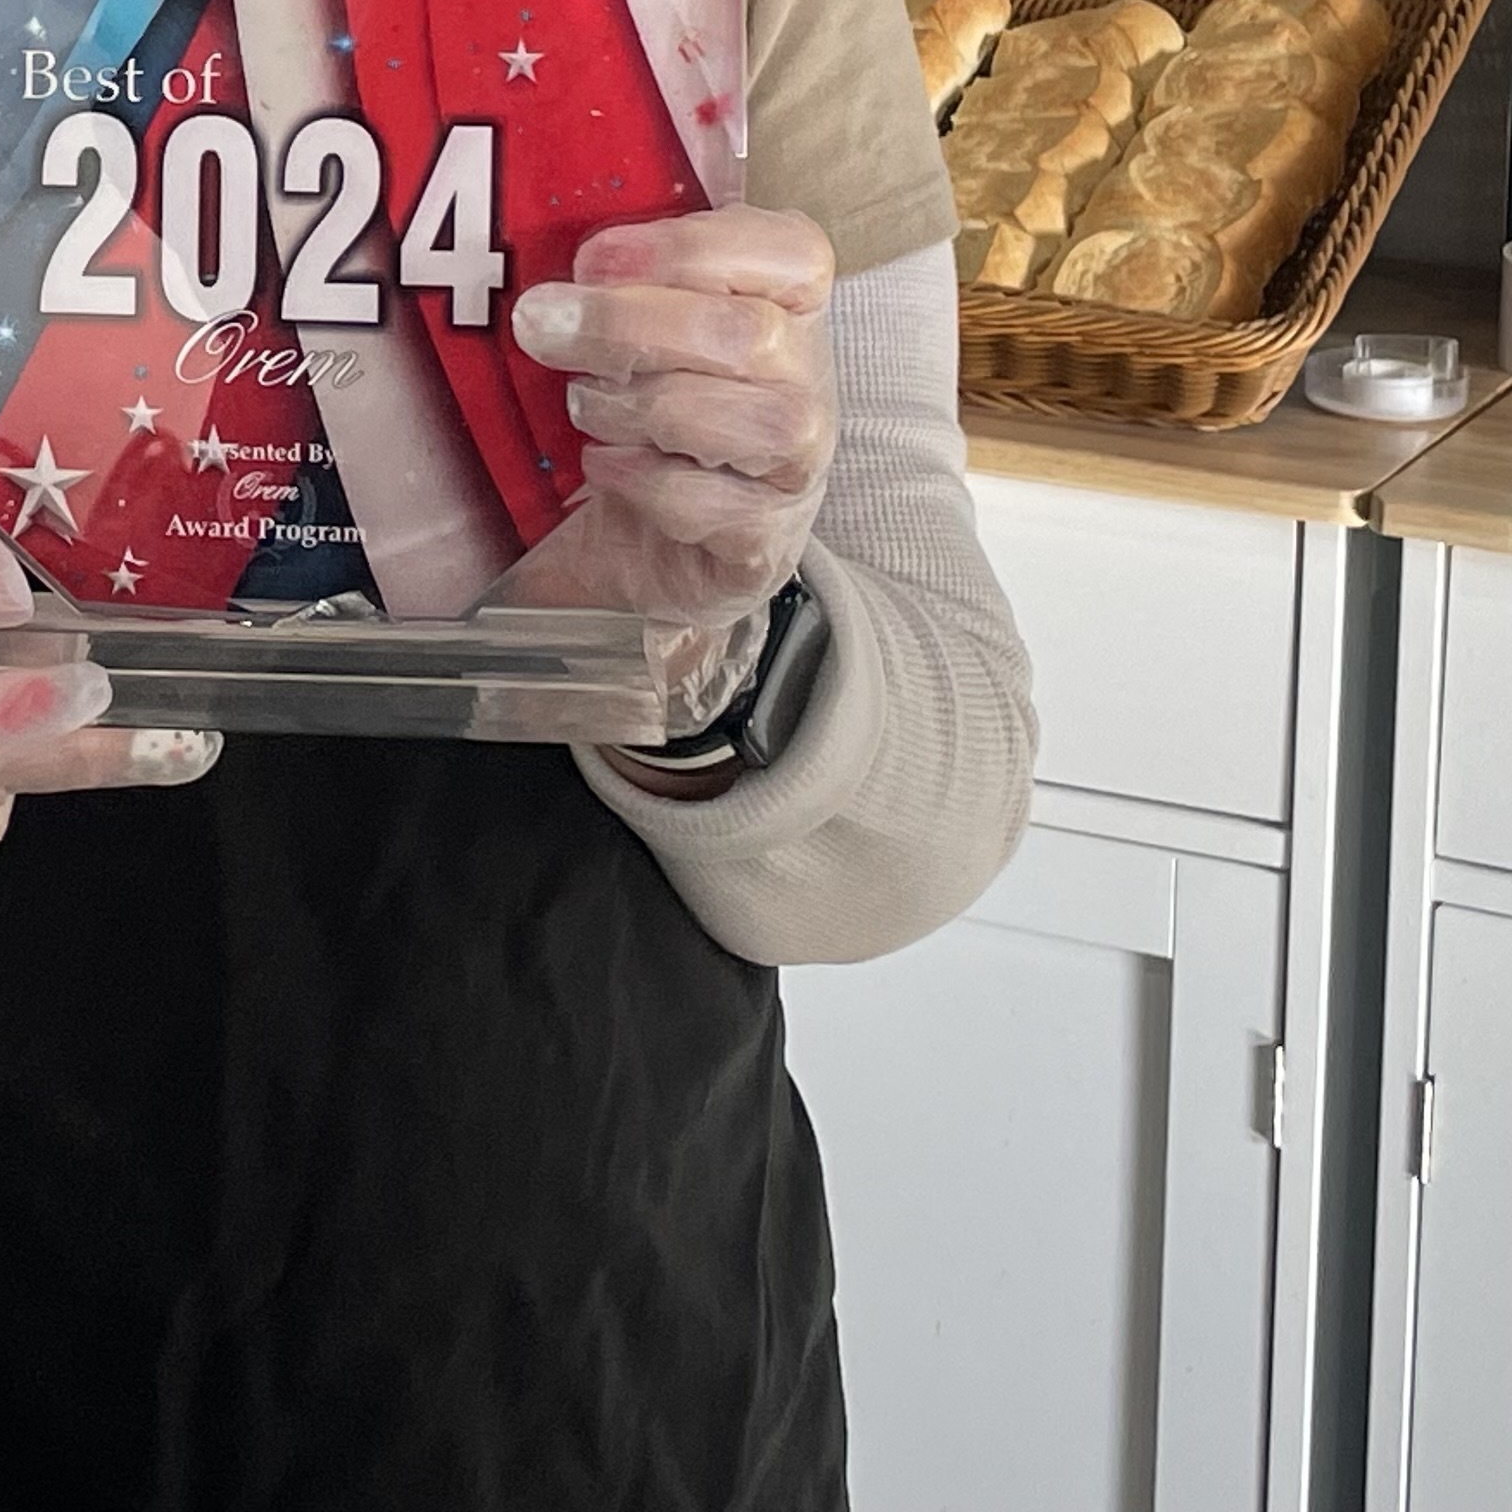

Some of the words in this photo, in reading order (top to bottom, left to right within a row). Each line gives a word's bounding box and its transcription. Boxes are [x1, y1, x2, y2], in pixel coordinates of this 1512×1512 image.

[21, 49, 145, 104] Best
[161, 52, 223, 105] of
[39, 110, 506, 327] 2024
[174, 308, 364, 389] Orem
[232, 470, 301, 501] Orem
[165, 513, 250, 538] Award
[258, 517, 368, 548] Program
